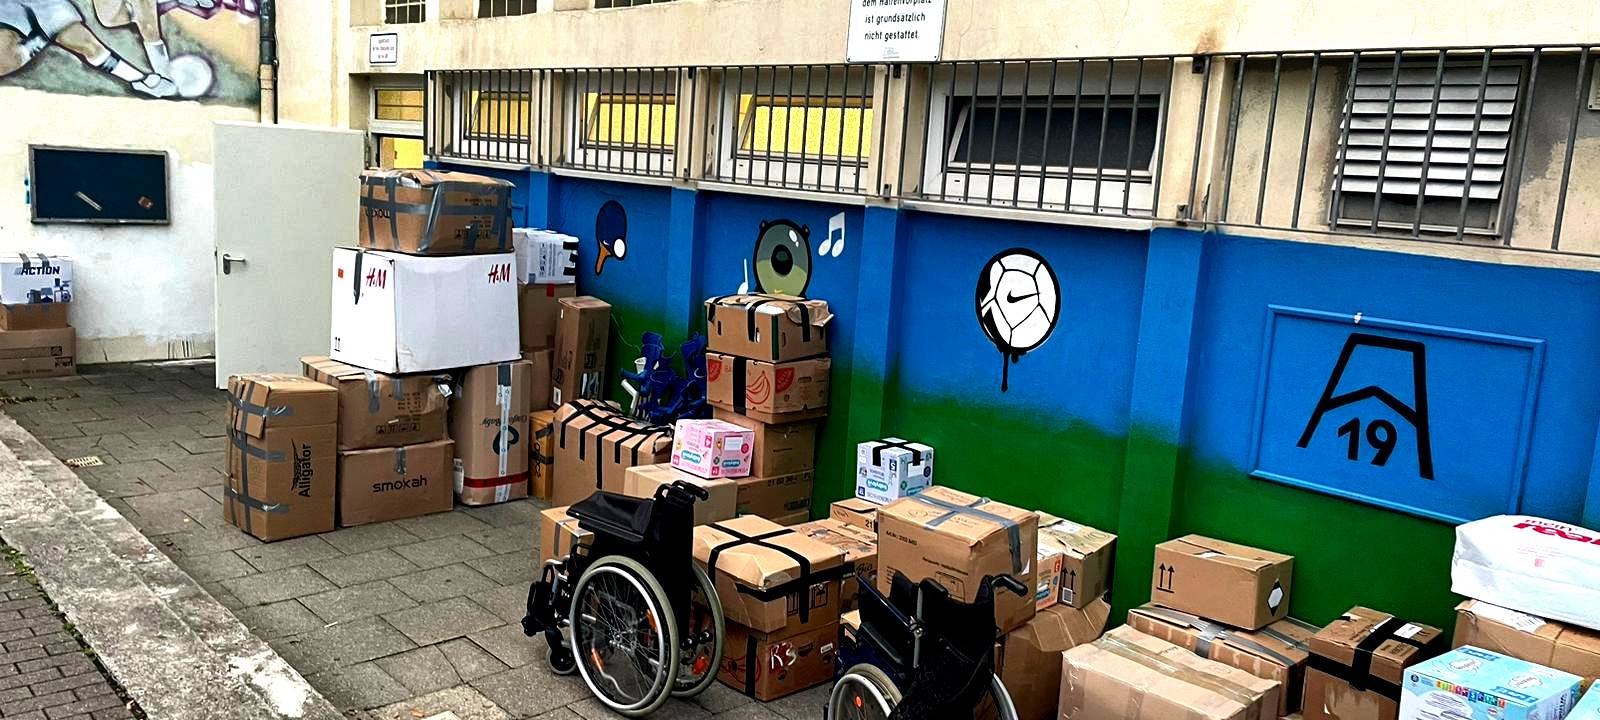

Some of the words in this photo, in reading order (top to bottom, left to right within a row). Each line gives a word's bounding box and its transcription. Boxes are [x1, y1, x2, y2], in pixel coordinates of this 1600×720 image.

[865, 15, 874, 23] ist
[865, 31, 882, 40] nicht
[20, 265, 60, 275] ACTION
[366, 267, 386, 289] H&M
[488, 263, 511, 284] H&M
[1338, 417, 1398, 467] 19
[298, 443, 313, 498] Alligator
[372, 475, 428, 493] smokah
